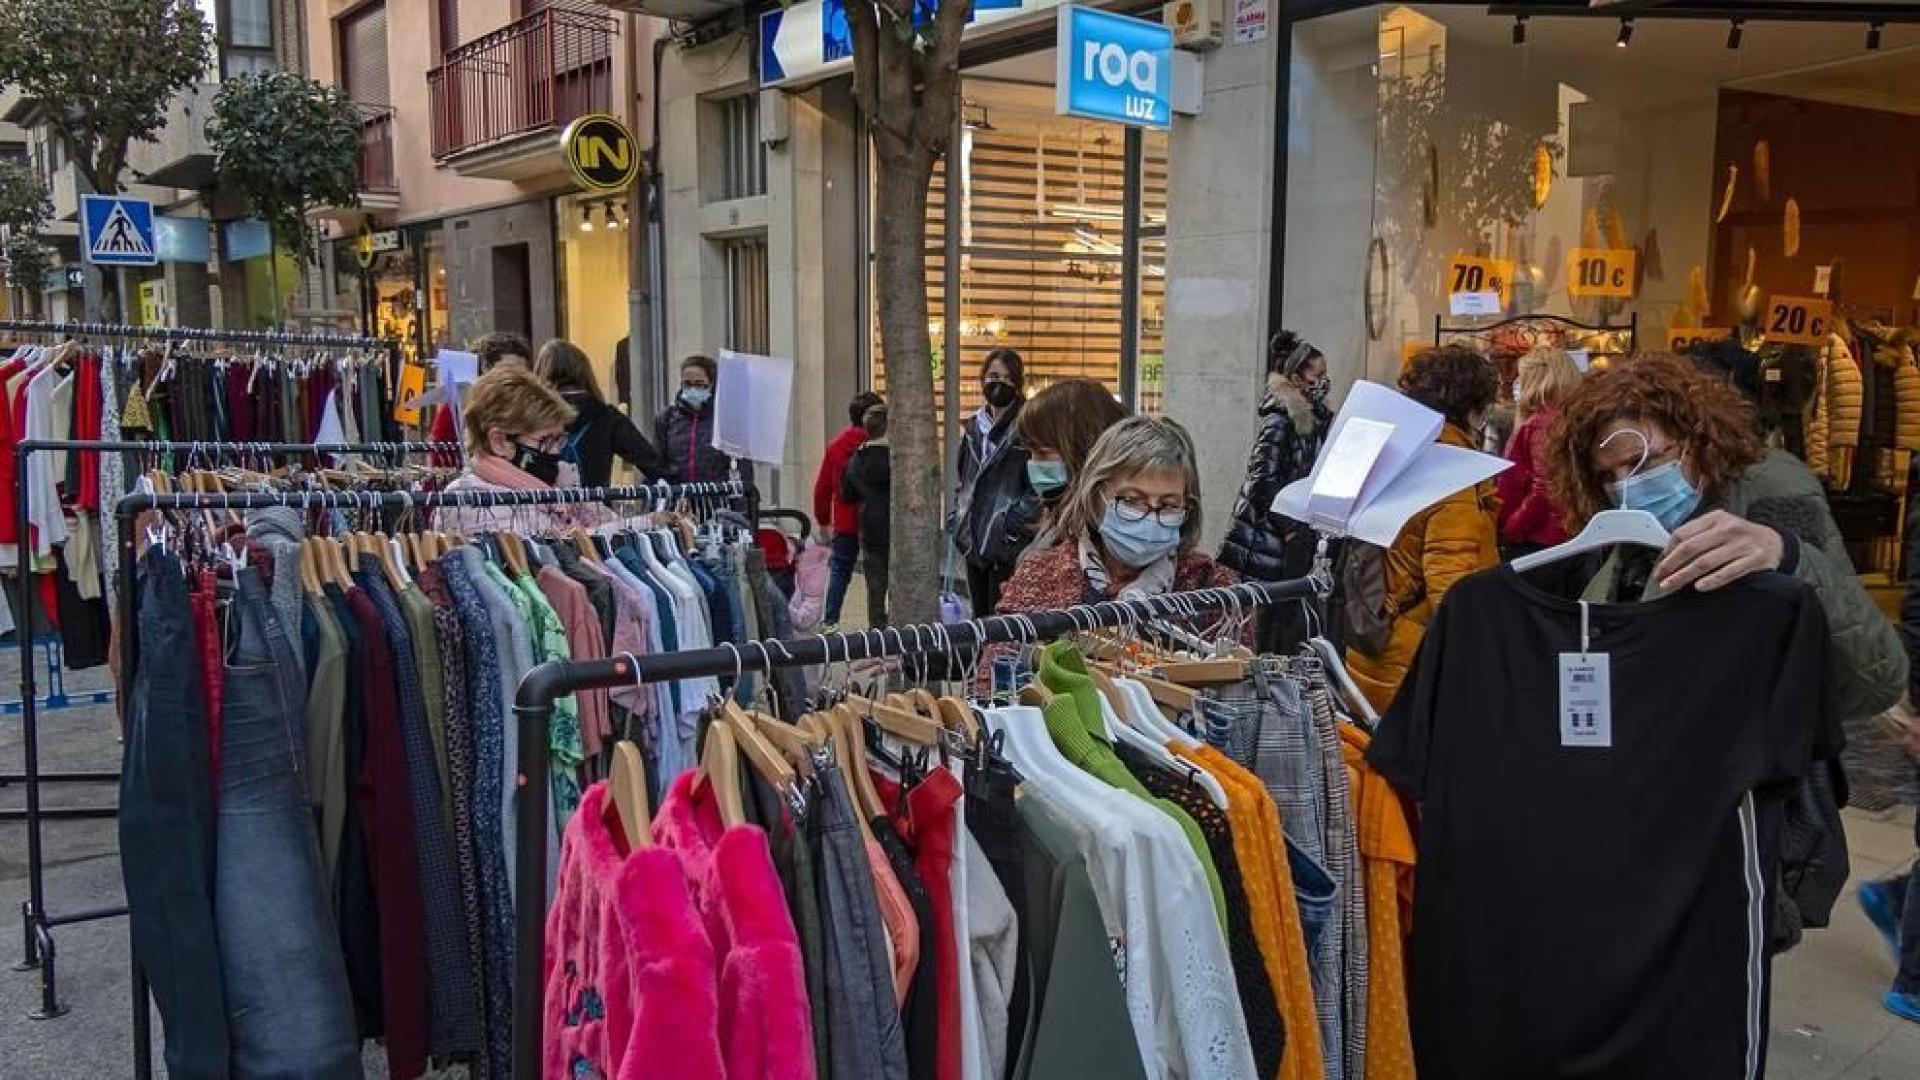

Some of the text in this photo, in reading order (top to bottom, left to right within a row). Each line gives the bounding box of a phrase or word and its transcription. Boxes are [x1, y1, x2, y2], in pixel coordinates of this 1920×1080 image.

[1084, 39, 1157, 94] roa
[1126, 94, 1155, 120] LUZ
[578, 136, 629, 170] IN
[1453, 264, 1484, 293] 70
[1577, 257, 1606, 287] 10
[1771, 304, 1806, 335] 20
